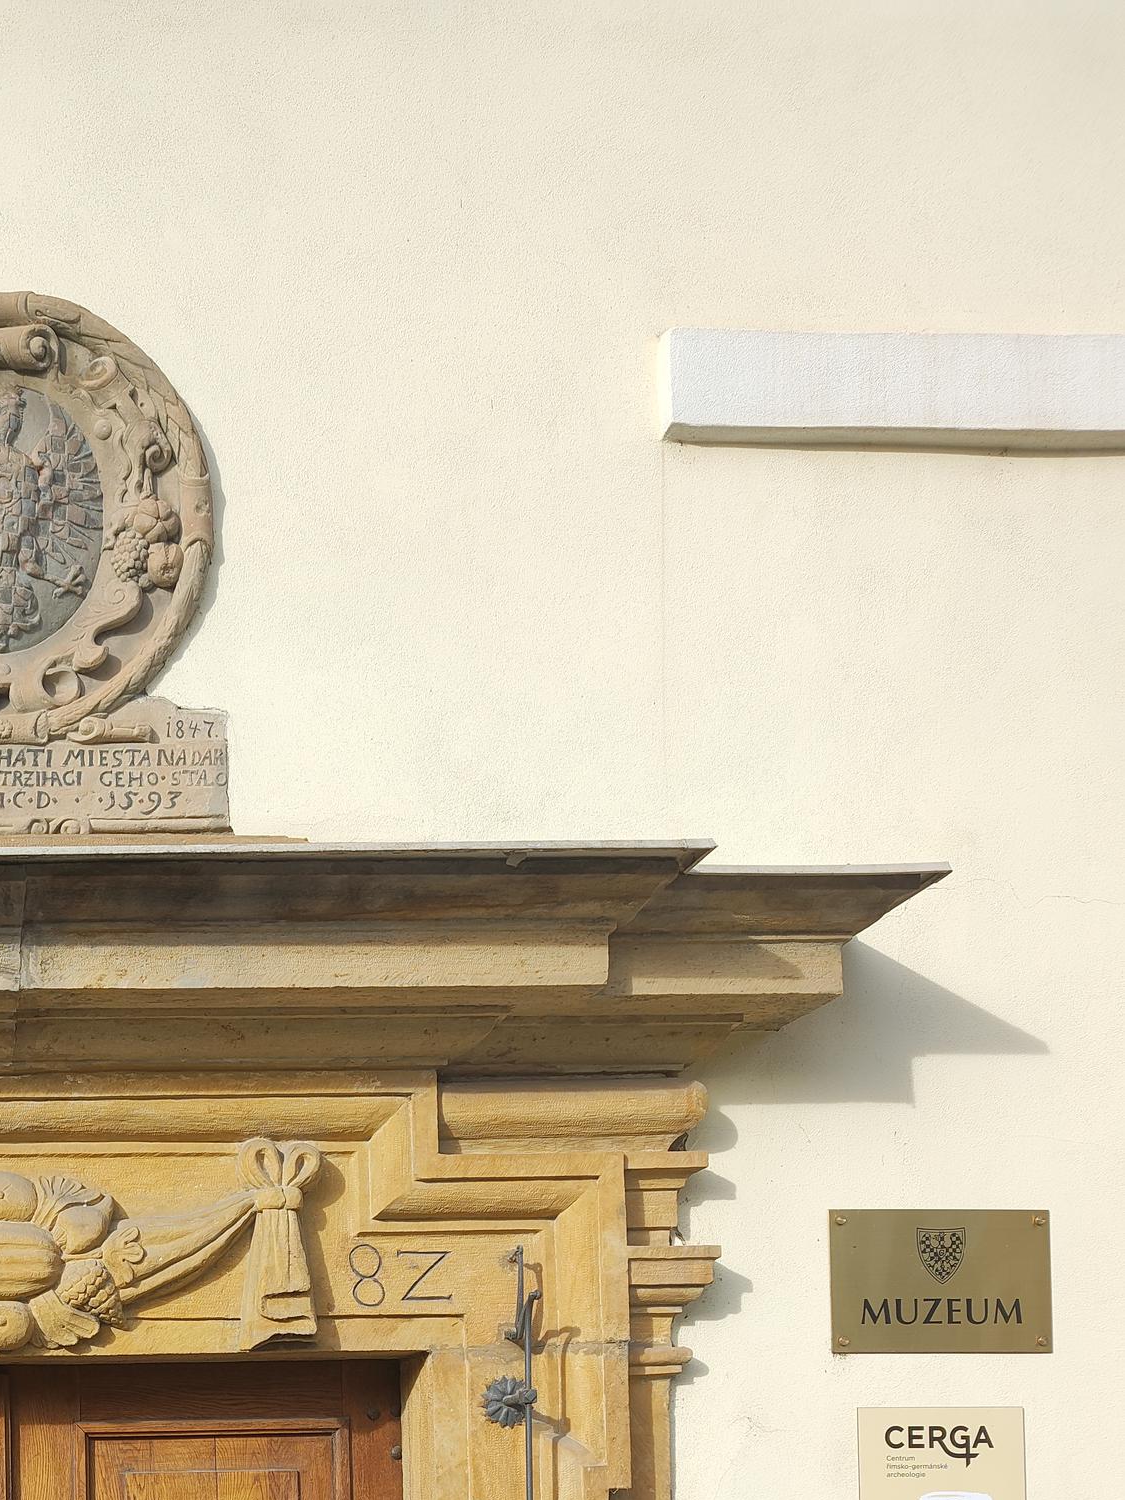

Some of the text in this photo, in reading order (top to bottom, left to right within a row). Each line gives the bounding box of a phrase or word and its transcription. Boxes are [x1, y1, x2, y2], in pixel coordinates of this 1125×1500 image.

[861, 1298, 1023, 1325] MUZEUM
[884, 1425, 995, 1468] CERGA
[886, 1463, 948, 1471] římsko-germánské
[886, 1471, 926, 1479] archeologie
